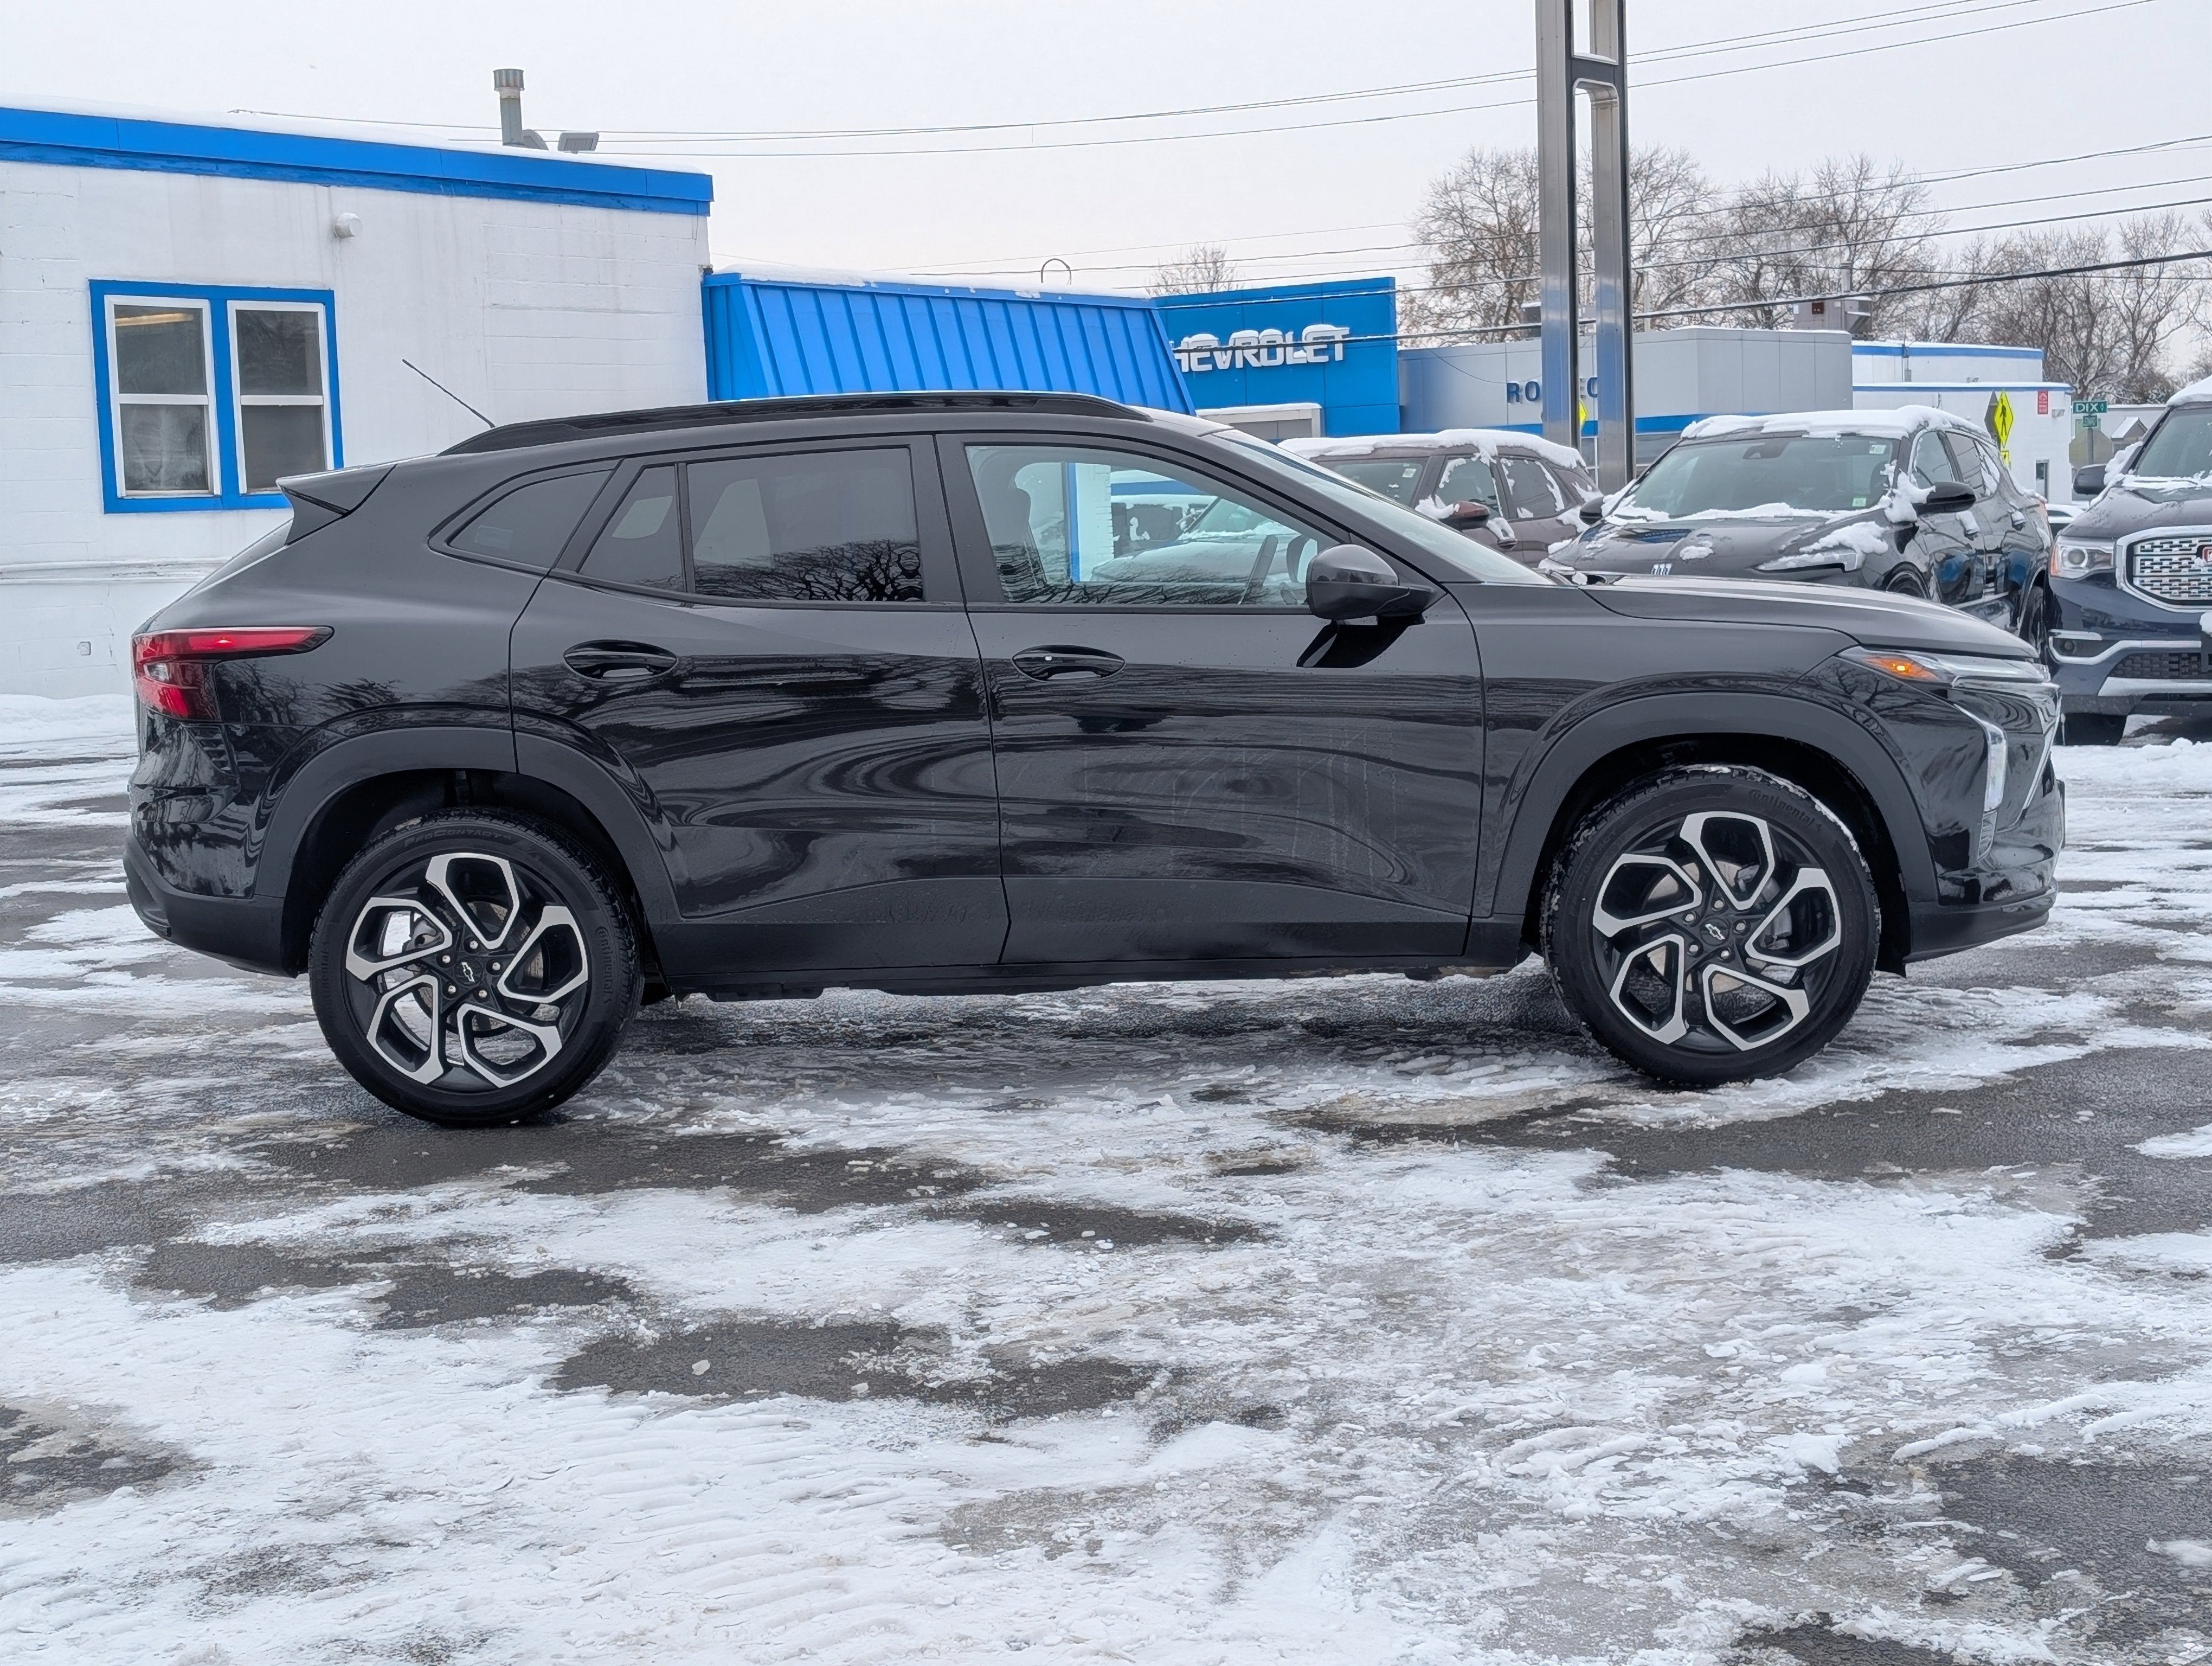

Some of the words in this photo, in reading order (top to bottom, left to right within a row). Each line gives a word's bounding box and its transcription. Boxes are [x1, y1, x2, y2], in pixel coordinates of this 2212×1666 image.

[1169, 324, 1350, 373] HEVROLET
[2075, 402, 2099, 412] DIX
[1749, 790, 1815, 825] Continental
[595, 926, 613, 994] Continental
